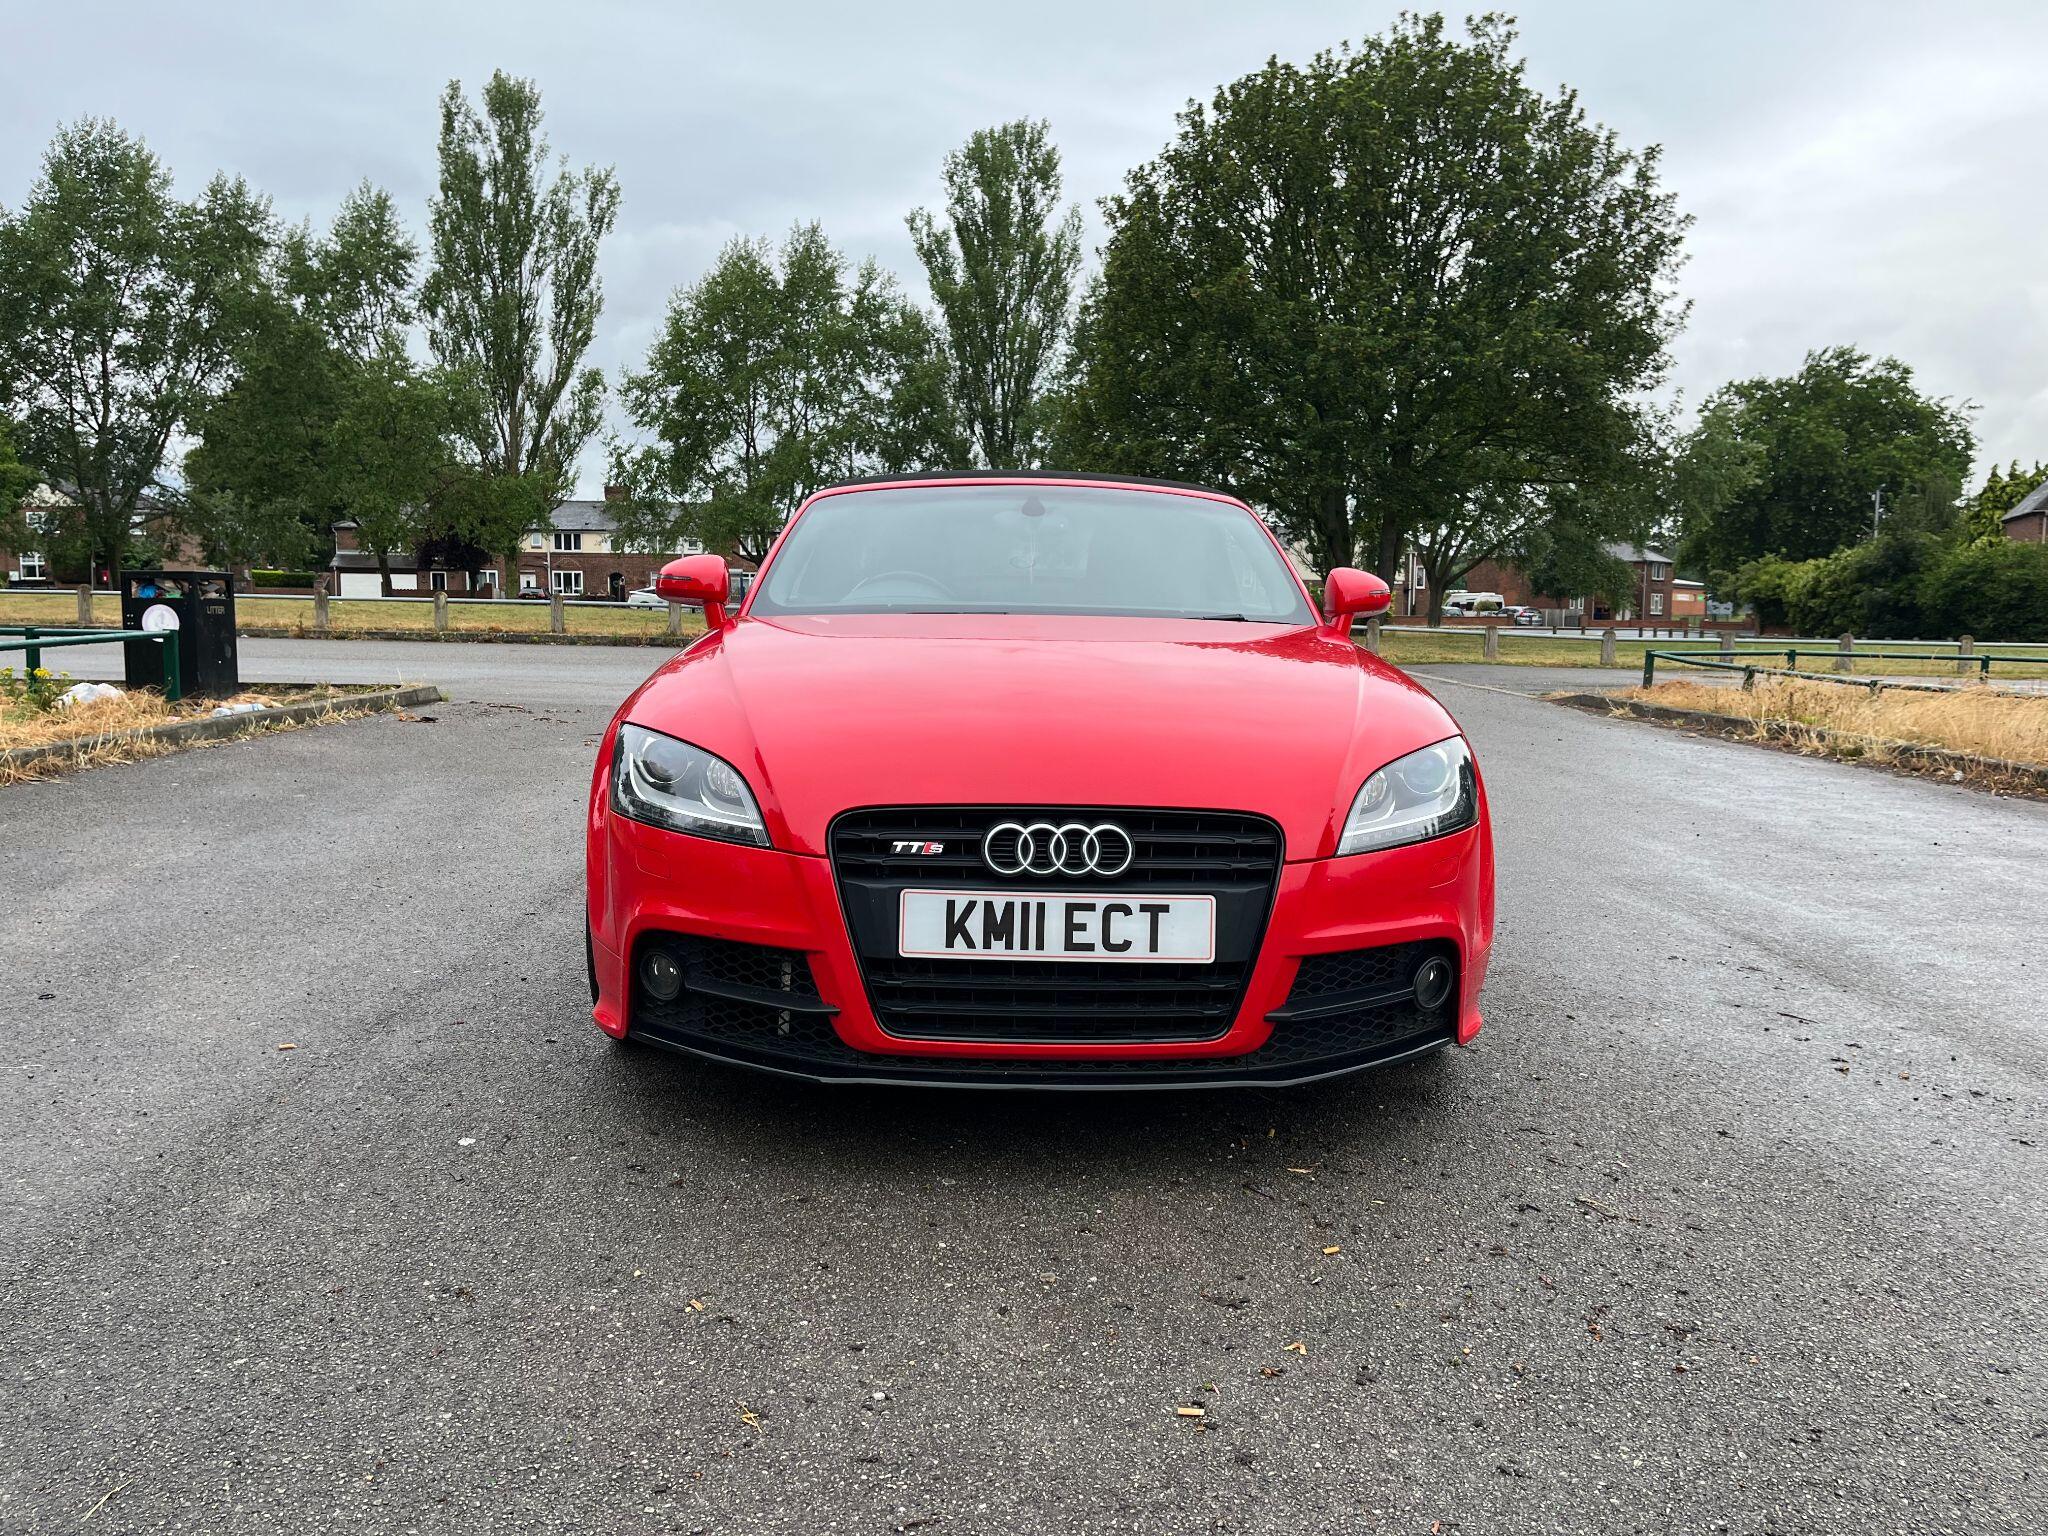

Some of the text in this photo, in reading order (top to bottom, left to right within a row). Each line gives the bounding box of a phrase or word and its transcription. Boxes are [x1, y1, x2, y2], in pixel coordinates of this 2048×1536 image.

[206, 605, 225, 615] LITTER
[892, 841, 944, 855] TTS
[945, 899, 1170, 953] KM11 ECT
